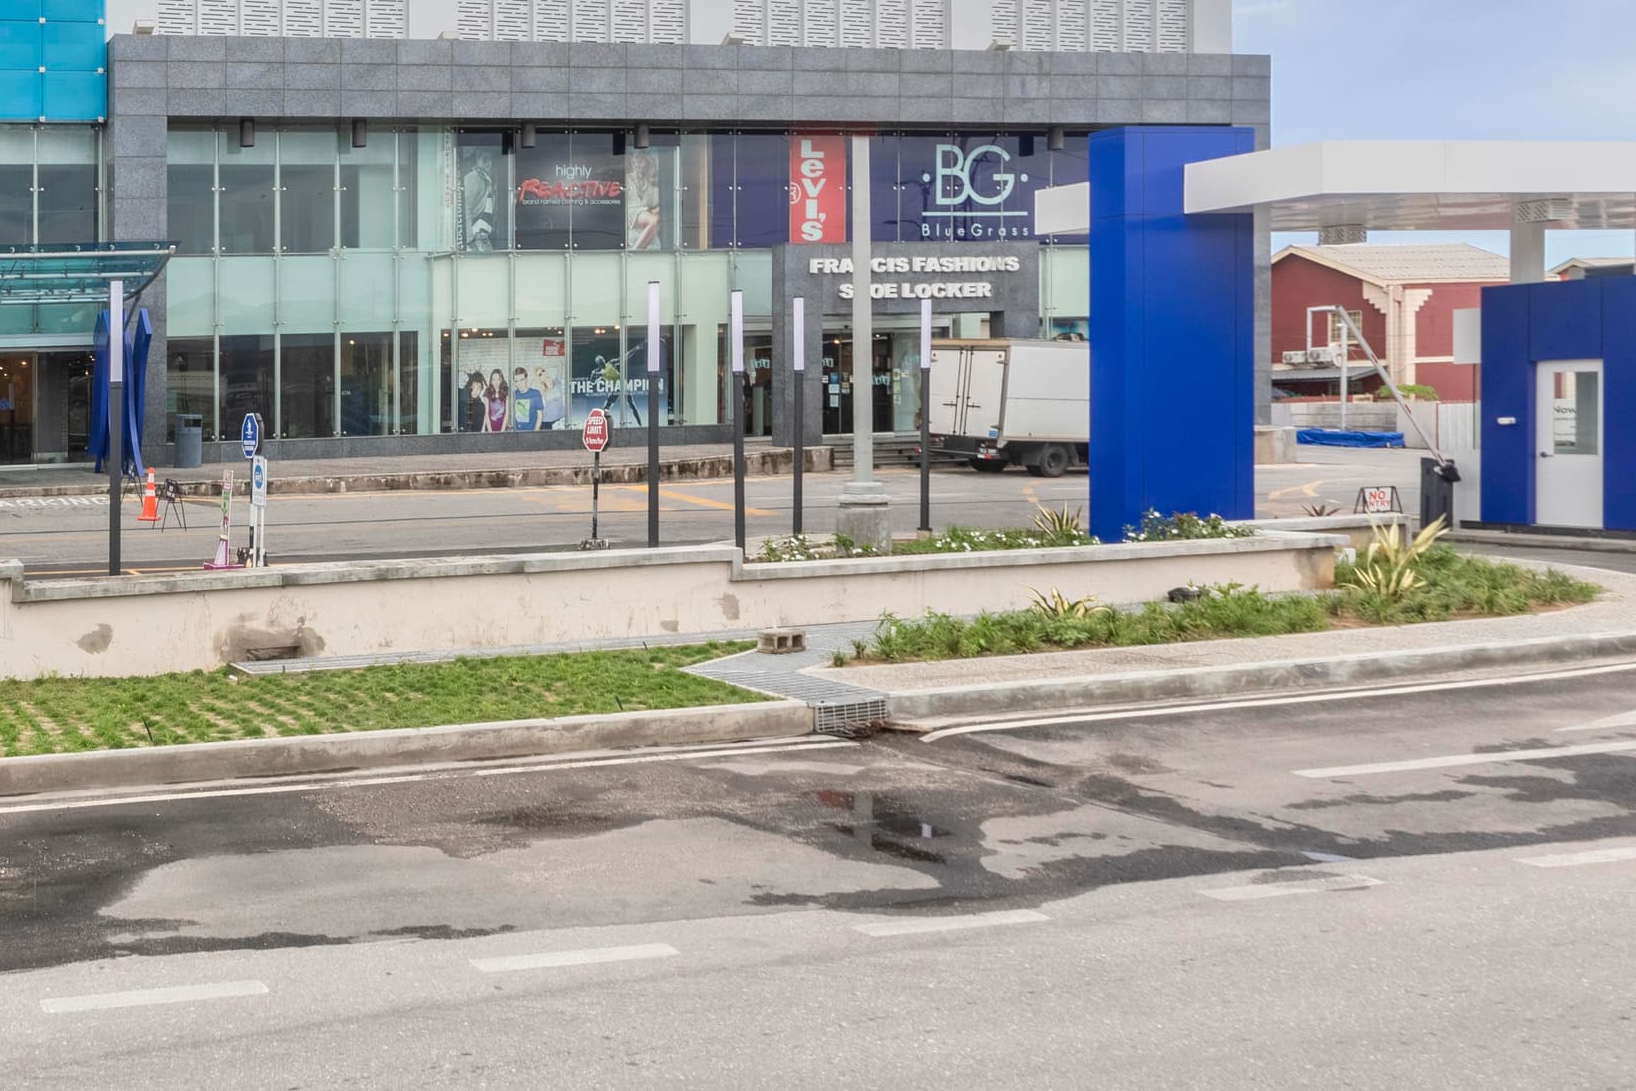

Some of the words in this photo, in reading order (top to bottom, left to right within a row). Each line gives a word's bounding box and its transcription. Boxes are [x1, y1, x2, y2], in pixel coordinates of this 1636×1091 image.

[555, 165, 592, 179] highly
[935, 144, 1015, 205] BG
[519, 178, 621, 202] REACTIVE
[809, 257, 910, 274] FRACIS
[912, 256, 1020, 273] FASHIONS
[839, 283, 898, 298] SOE
[901, 282, 992, 298] LOCKER
[569, 380, 594, 394] THE
[596, 378, 664, 393] CHAMPIN
[1369, 490, 1386, 500] NO
